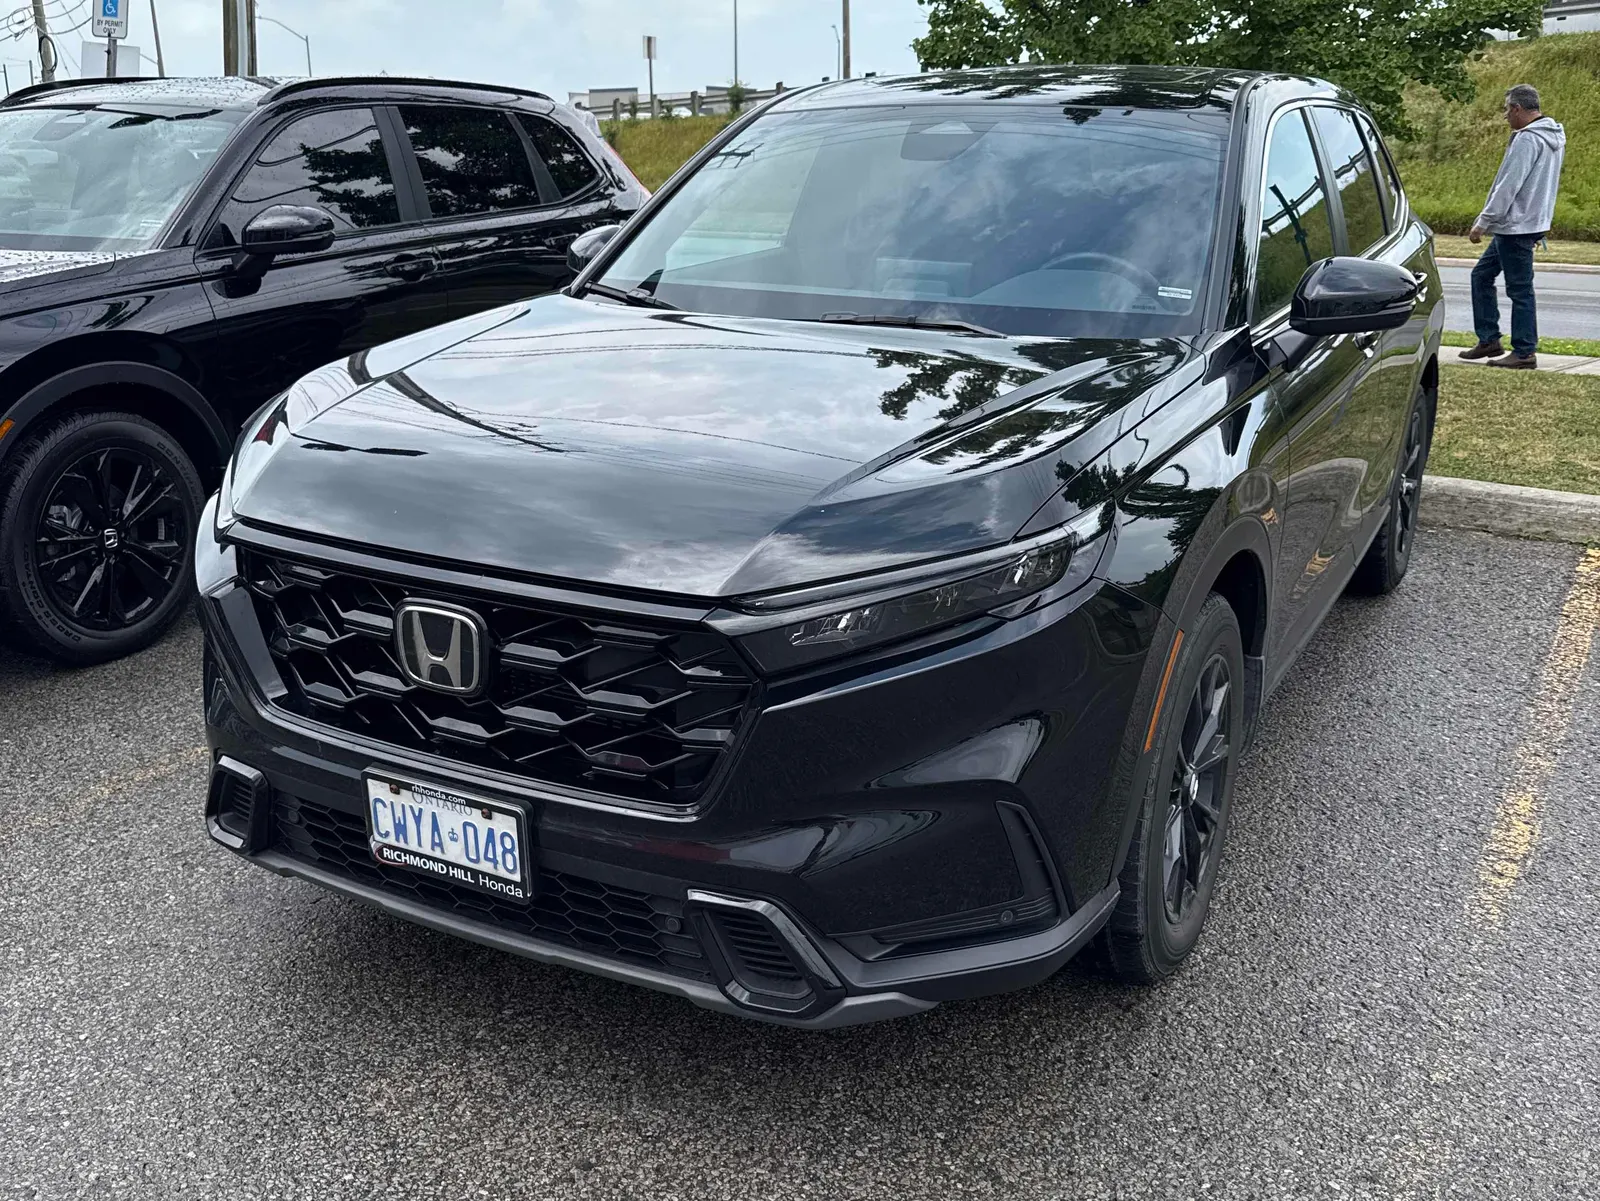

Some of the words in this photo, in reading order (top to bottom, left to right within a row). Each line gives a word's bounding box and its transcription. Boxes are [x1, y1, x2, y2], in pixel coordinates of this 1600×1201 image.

[104, 20, 123, 28] PERMIT
[411, 785, 467, 805] rhhonda.com
[412, 792, 473, 817] ONTARIO
[372, 797, 446, 855] CWYA
[462, 820, 518, 874] 048
[383, 847, 447, 874] RICHMOND
[449, 866, 475, 883] HILL
[479, 875, 524, 899] Honda
